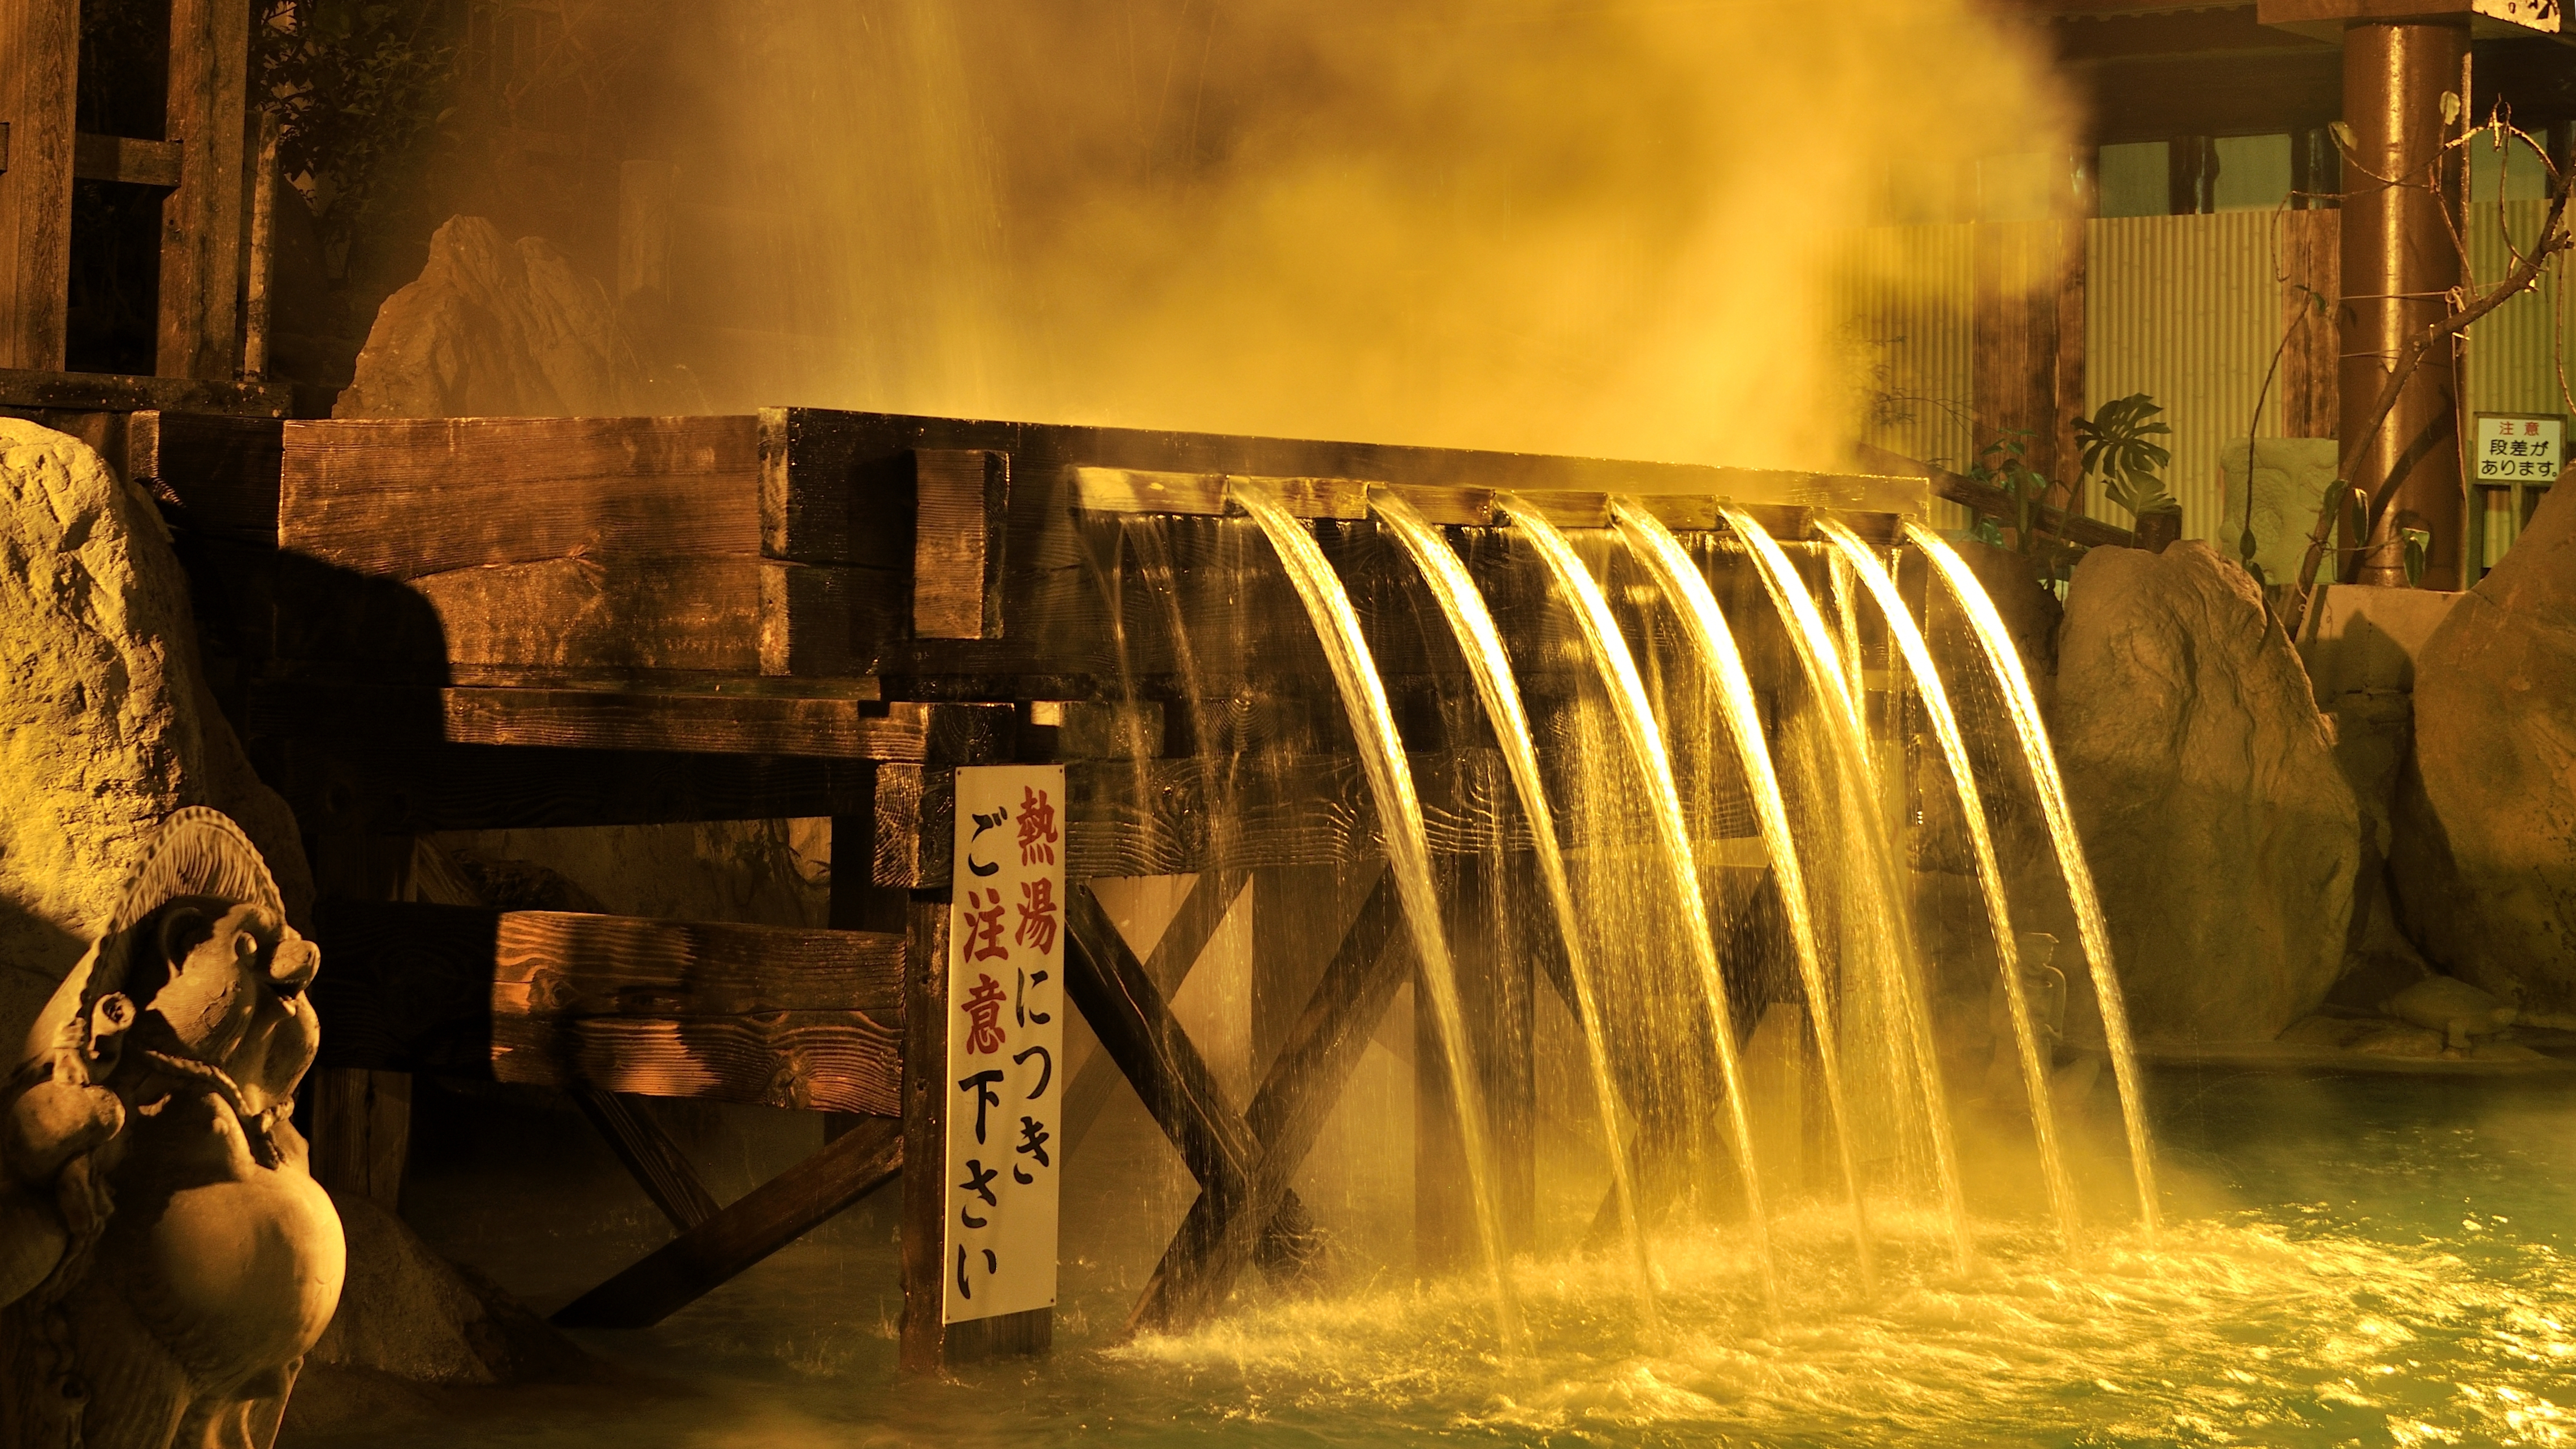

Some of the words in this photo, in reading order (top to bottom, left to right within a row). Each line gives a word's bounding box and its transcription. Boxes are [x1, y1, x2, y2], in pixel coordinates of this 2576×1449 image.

[2499, 421, 2539, 436] 注意
[2489, 439, 2549, 457] 段差が
[2481, 459, 2557, 477] あります。
[1013, 786, 1058, 1185] 熱湯につき
[958, 806, 1010, 1300] ご注意下さい
